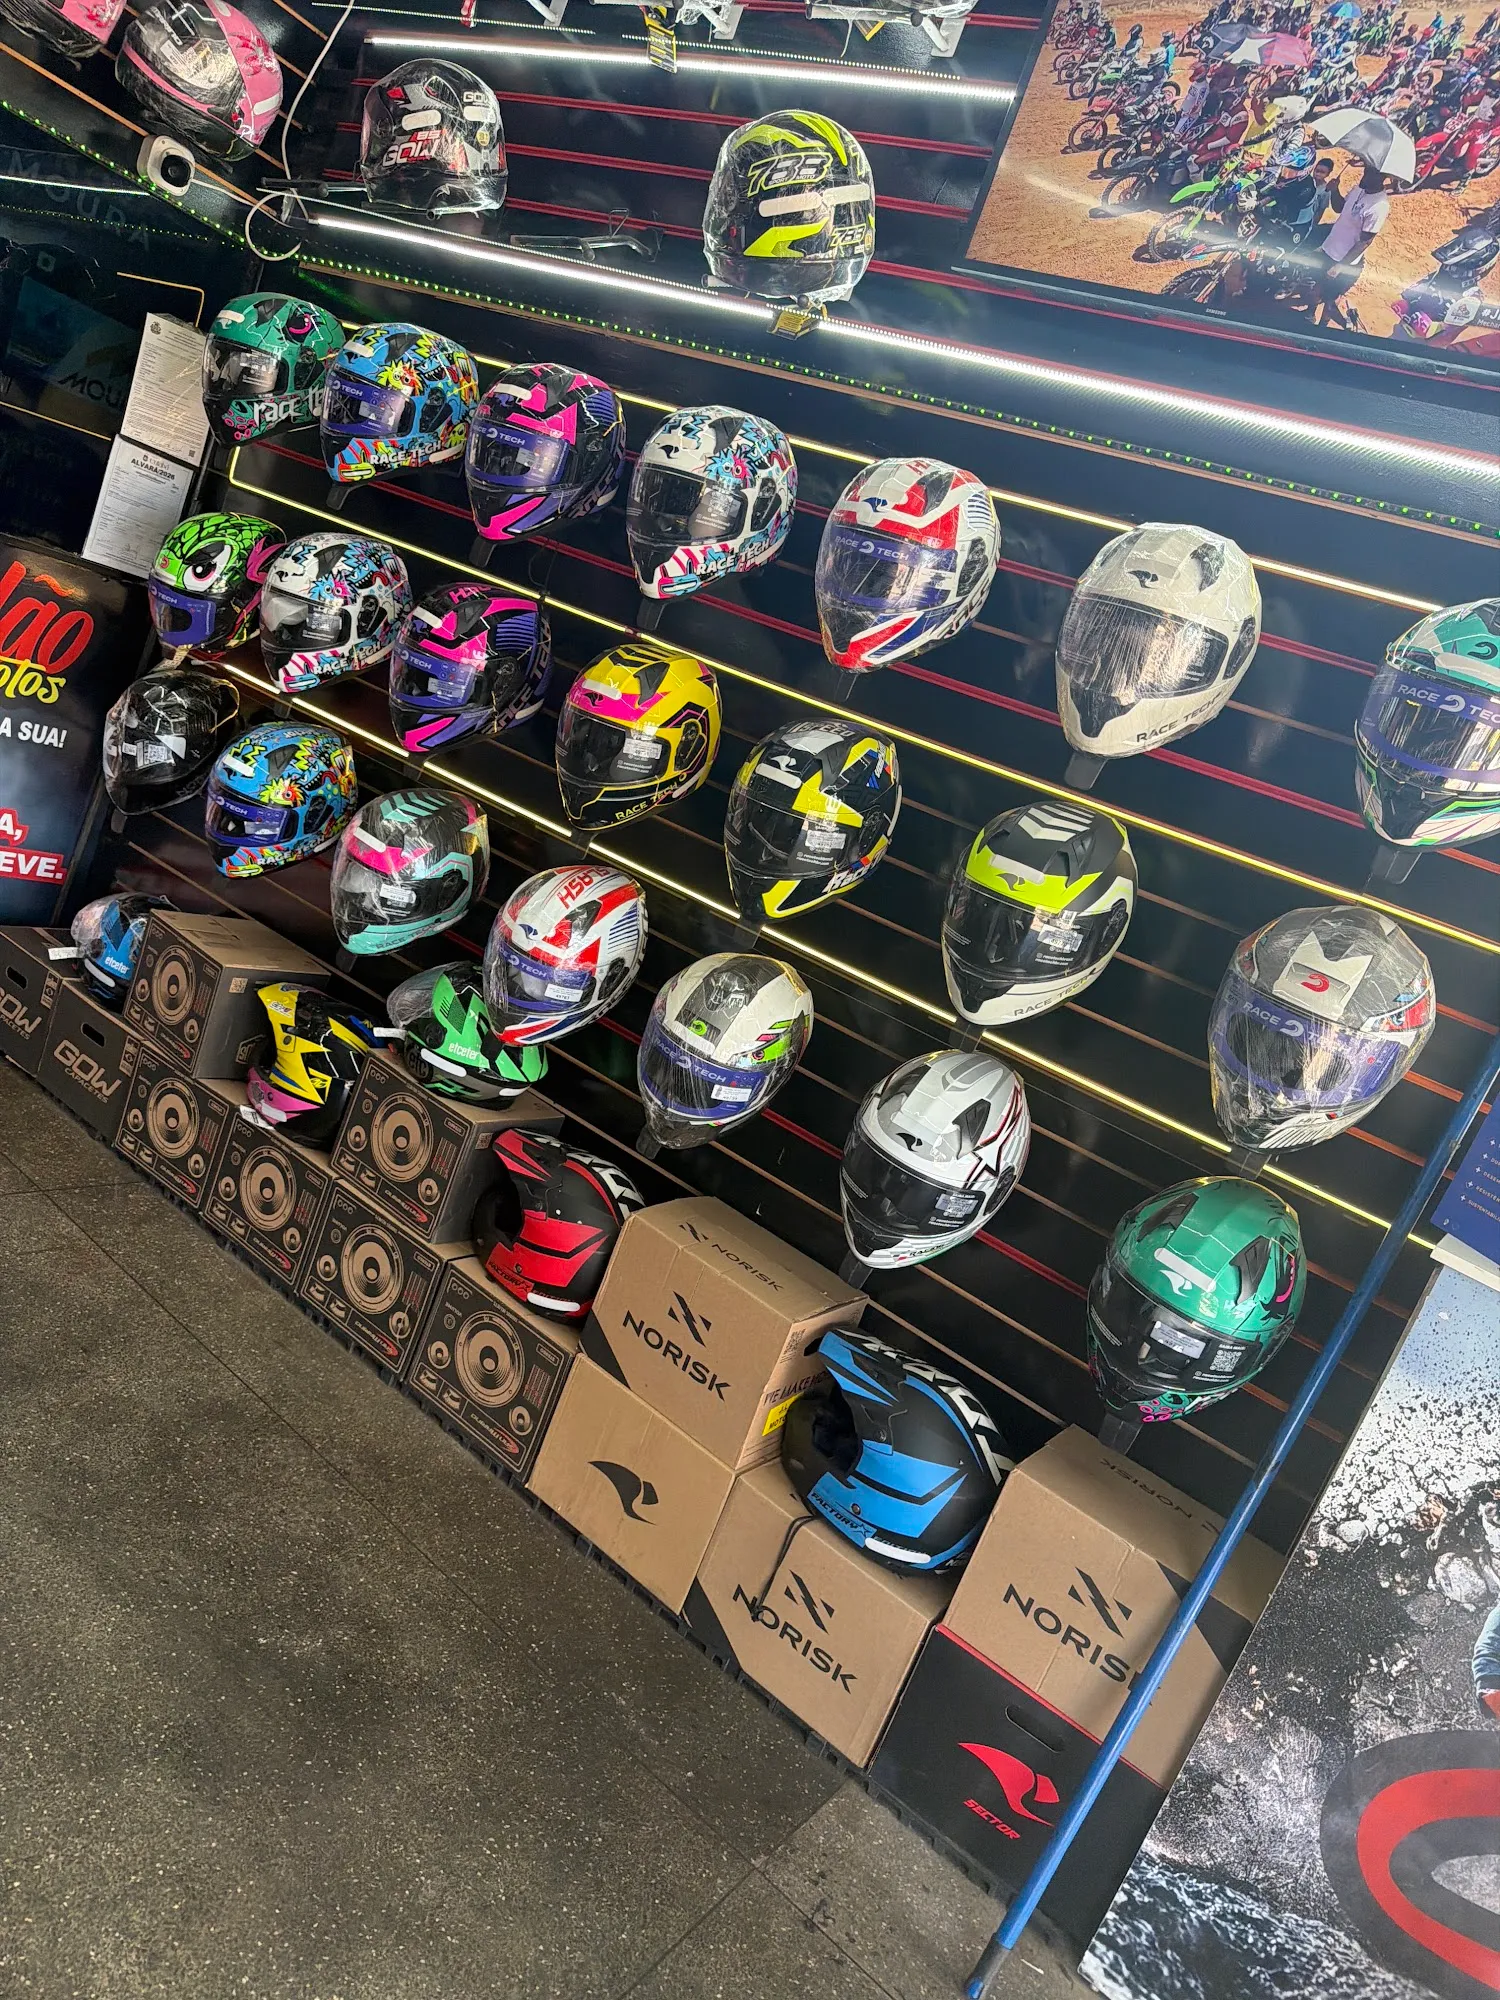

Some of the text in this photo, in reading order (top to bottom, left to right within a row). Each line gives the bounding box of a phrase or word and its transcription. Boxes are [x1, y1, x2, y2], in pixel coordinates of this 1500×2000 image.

[341, 384, 363, 397] TECH
[500, 432, 526, 446] TECH
[370, 440, 442, 465] RACE TECH
[697, 539, 770, 575] RACE TECH
[835, 535, 910, 561] RACE TECH
[158, 593, 178, 604] TECH
[314, 660, 348, 675] RACE
[410, 656, 432, 670] TECH
[1398, 684, 1441, 703] RACE
[1136, 698, 1216, 743] RACE TECH
[17, 720, 68, 749] SUA!
[226, 804, 248, 815] TECH
[615, 781, 678, 820] RACE TECH
[257, 850, 292, 865] RACE
[375, 938, 407, 950] RACE
[105, 955, 131, 974] etceter
[521, 963, 548, 978] TECH
[1014, 997, 1053, 1017] RACE
[1243, 1002, 1282, 1025] RACE
[448, 1042, 480, 1061] etceter
[53, 1039, 122, 1098] GOW
[694, 1065, 727, 1083] TECH
[64, 1066, 109, 1105] CAPACETES
[711, 1243, 785, 1292] NORISK
[622, 1309, 731, 1402] NORISK
[1101, 1458, 1193, 1520] NORISK
[810, 1492, 858, 1529] FACTORY
[732, 1583, 858, 1695] NORISK
[1002, 1583, 1163, 1707] NORIS
[961, 1797, 1022, 1841] SECTOR
